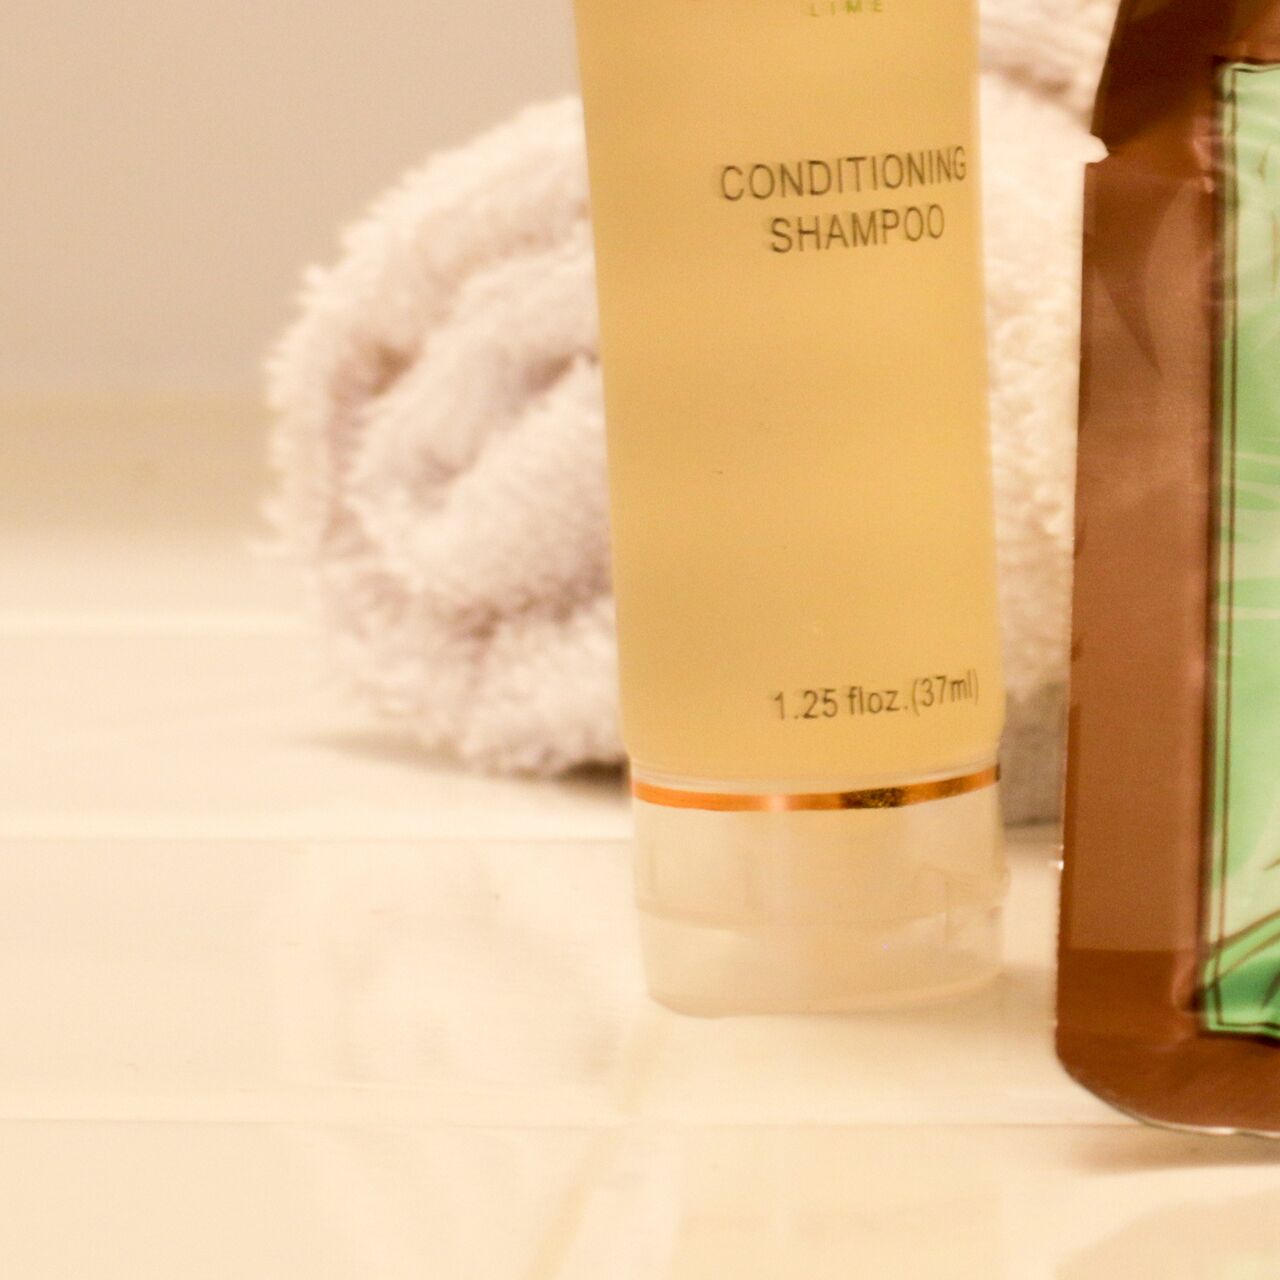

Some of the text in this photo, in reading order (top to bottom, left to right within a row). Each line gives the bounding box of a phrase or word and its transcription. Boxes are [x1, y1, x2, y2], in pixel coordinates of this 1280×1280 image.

[720, 145, 967, 201] CONDITIONING
[769, 203, 946, 254] SHAMPOO
[772, 687, 839, 721] 1.25
